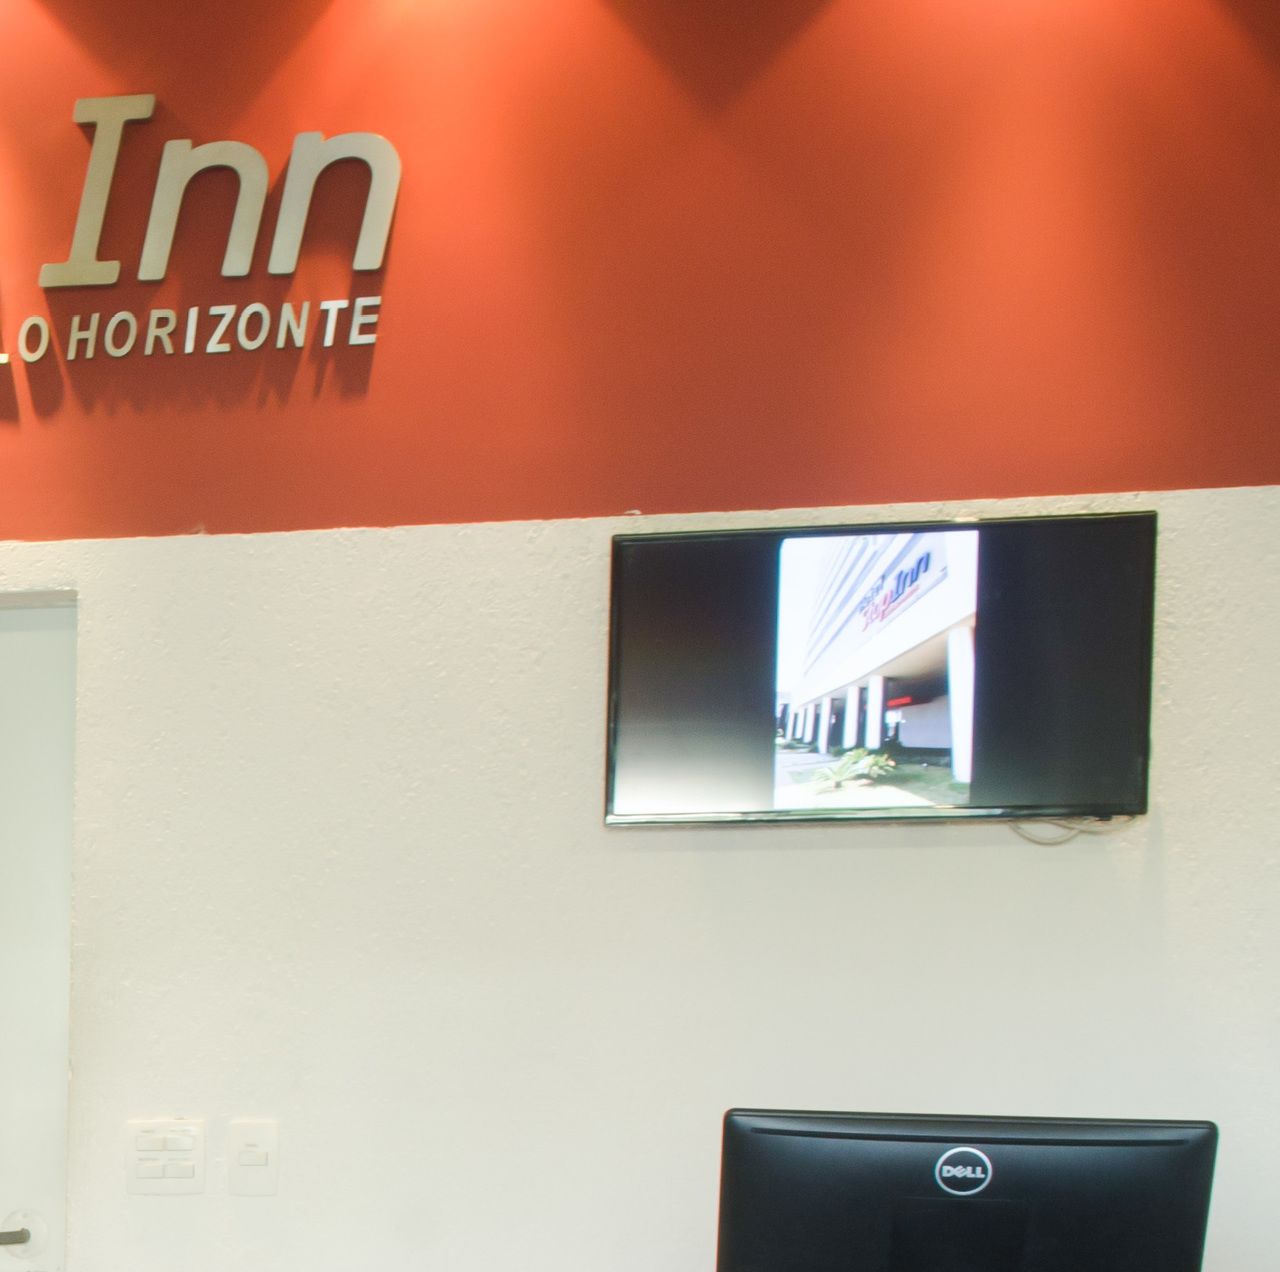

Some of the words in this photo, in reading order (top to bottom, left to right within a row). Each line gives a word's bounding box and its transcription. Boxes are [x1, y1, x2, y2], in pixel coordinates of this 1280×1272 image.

[39, 93, 403, 290] Inn
[67, 296, 383, 361] HORIZONTE
[942, 1165, 986, 1178] DELL
